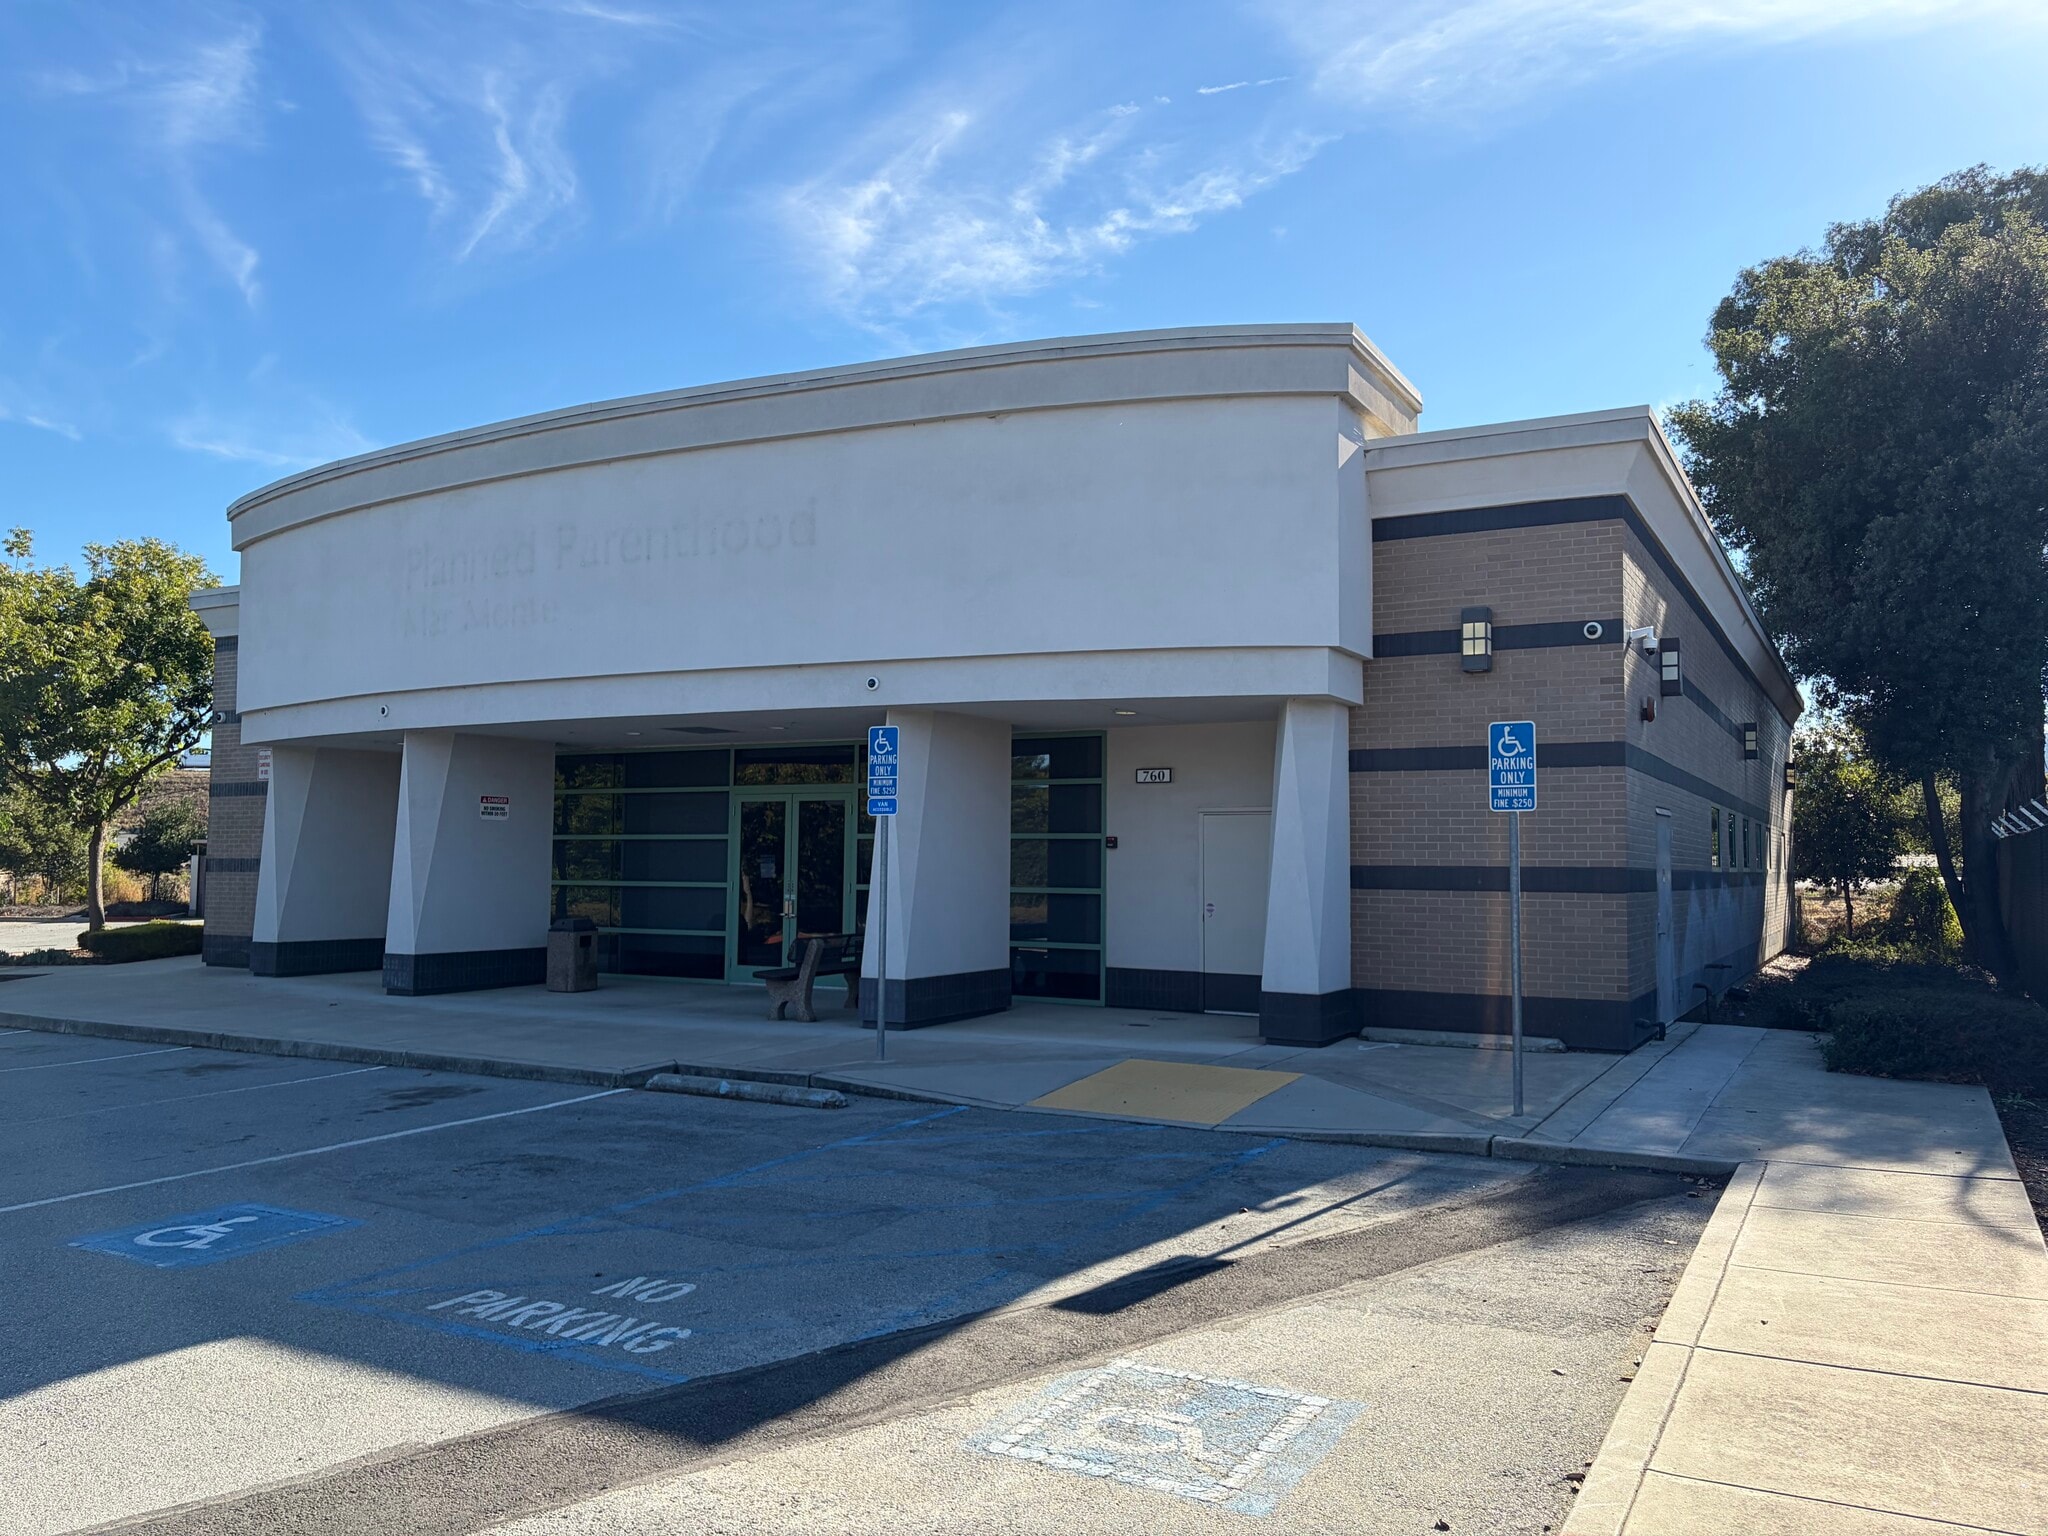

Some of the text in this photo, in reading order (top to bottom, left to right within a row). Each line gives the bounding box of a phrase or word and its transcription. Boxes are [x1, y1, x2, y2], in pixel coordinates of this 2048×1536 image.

[406, 495, 819, 592] Planned Parenthood
[869, 754, 897, 765] PARKING
[1491, 756, 1533, 770] PARKING
[875, 765, 892, 776] ONLY
[1142, 770, 1165, 782] 760
[1500, 771, 1525, 784] ONLY
[870, 787, 881, 795] FINE
[1497, 788, 1528, 797] MINIMUM
[1493, 799, 1509, 808] FINE
[590, 1275, 698, 1303] NO
[426, 1289, 692, 1354] PARKING
